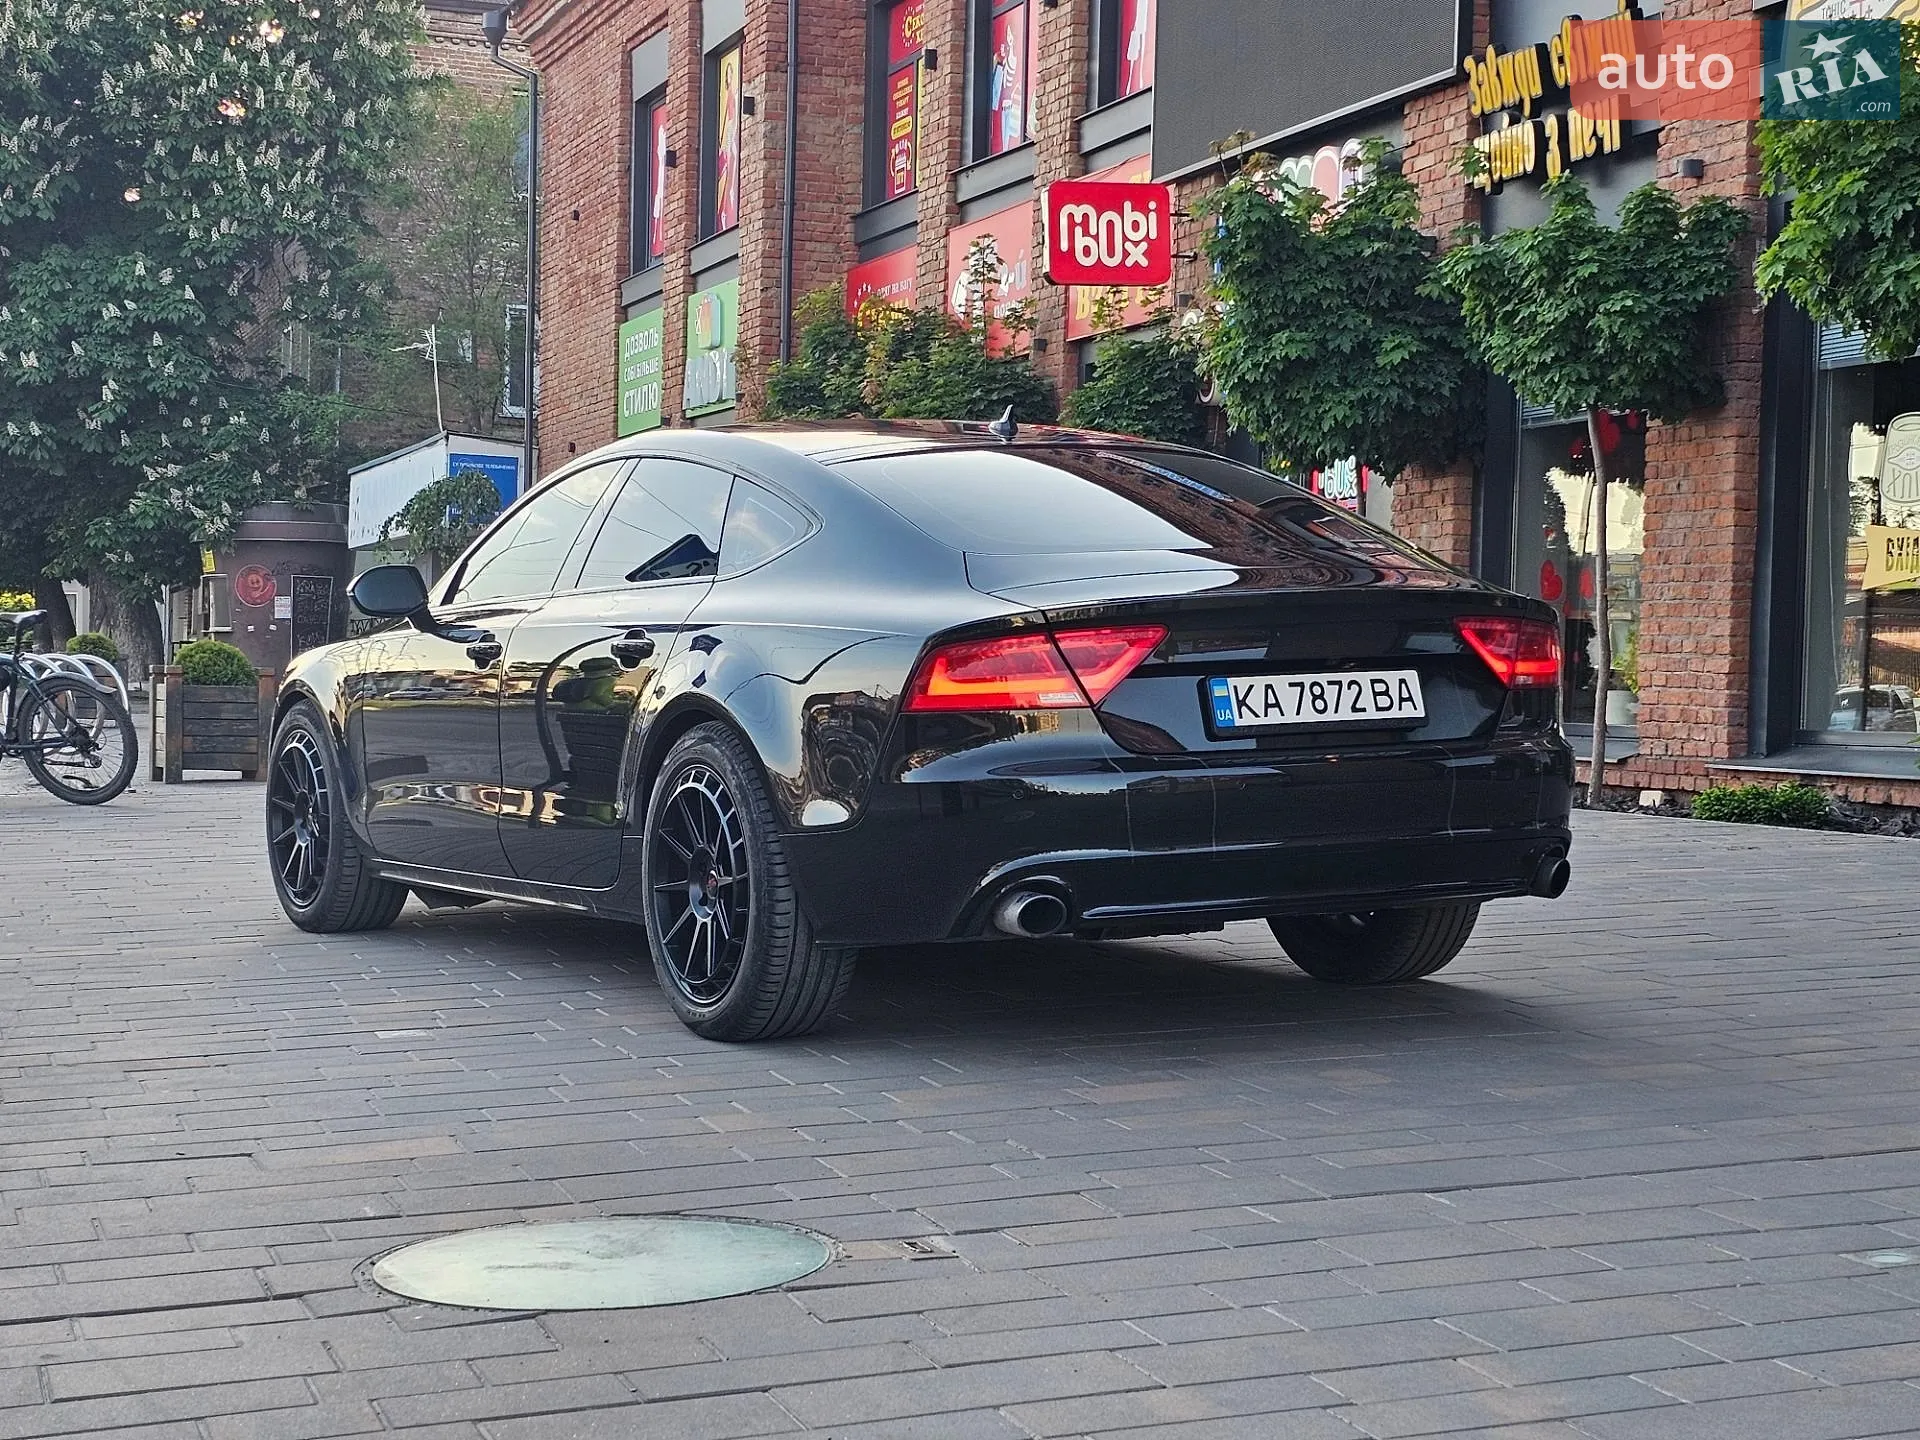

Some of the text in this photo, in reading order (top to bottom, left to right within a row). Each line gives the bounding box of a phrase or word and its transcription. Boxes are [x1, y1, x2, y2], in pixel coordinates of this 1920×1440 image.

[1059, 201, 1157, 267] mobi
[1074, 211, 1149, 268] box
[624, 327, 659, 362] ДОЗВОЛЬ
[623, 381, 659, 418] СТИЛЮ
[1217, 709, 1233, 721] UA
[1232, 678, 1418, 720] KA7872BA
